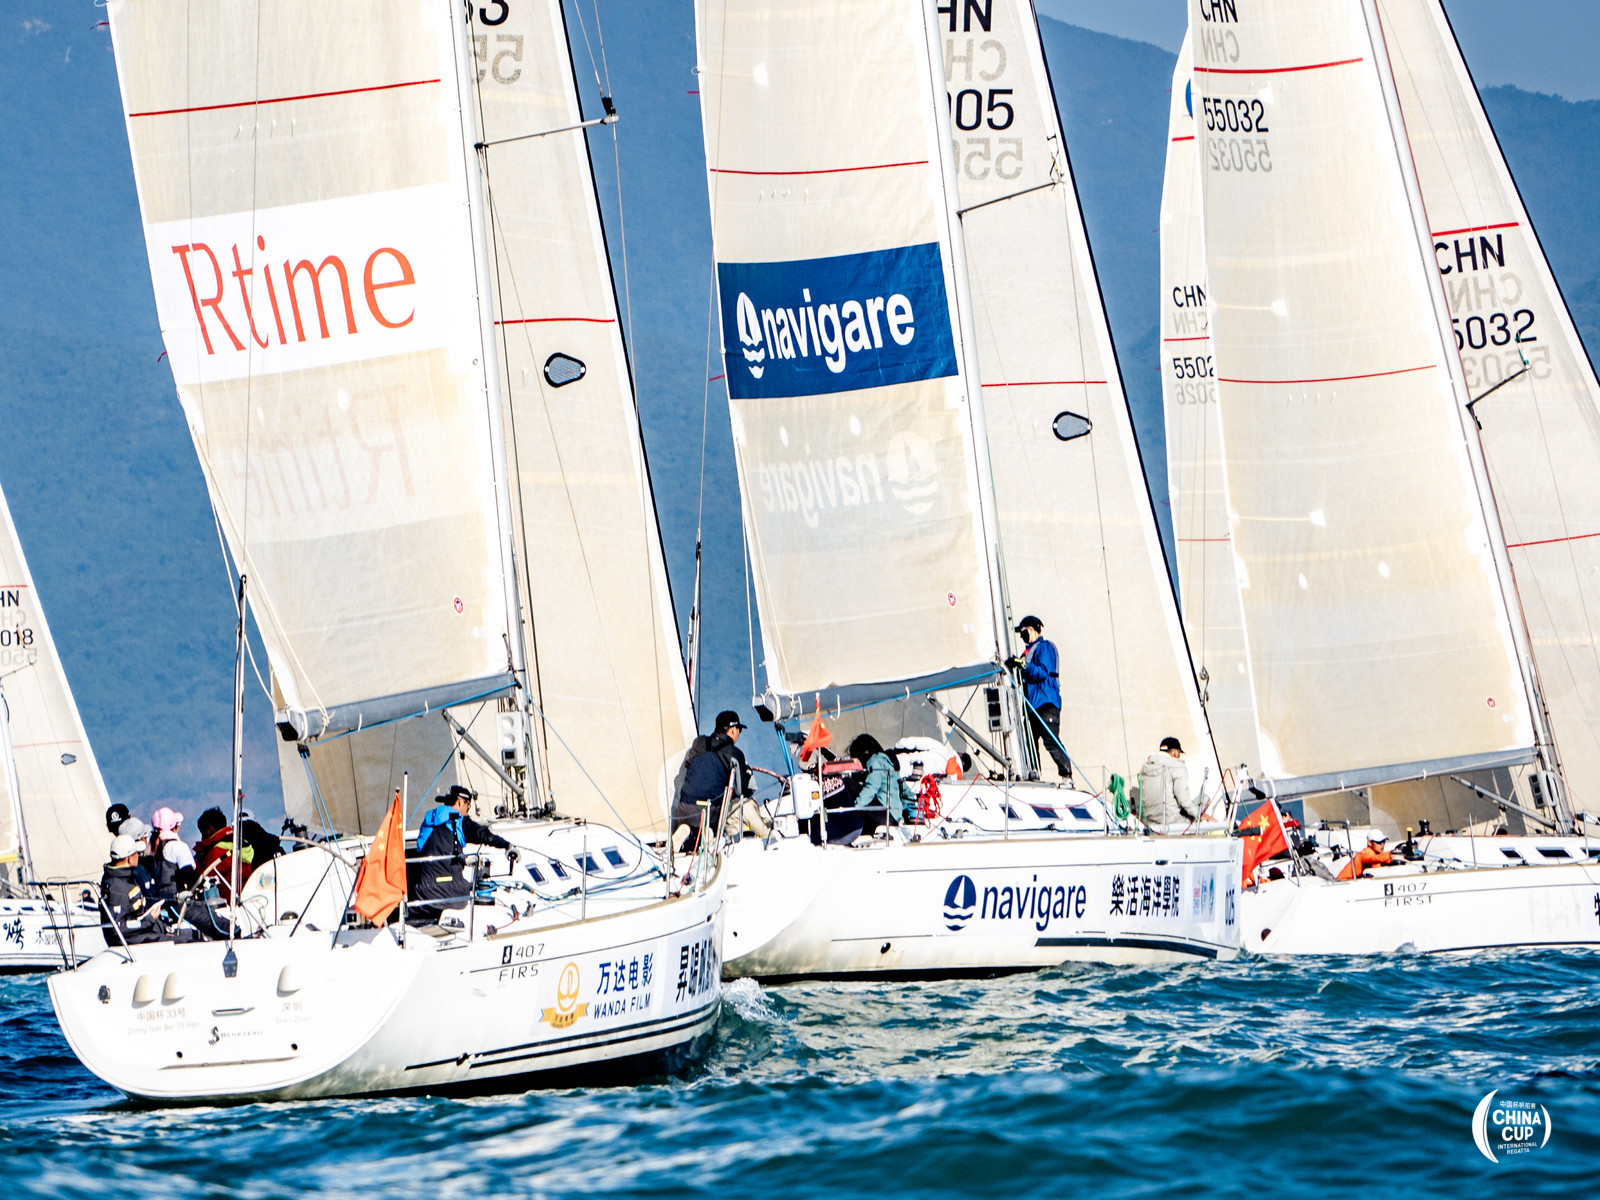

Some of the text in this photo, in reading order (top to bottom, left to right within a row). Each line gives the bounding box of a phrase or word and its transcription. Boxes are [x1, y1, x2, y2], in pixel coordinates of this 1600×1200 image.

[1200, 0, 1239, 23] CHN
[947, 89, 1014, 131] 05
[1203, 97, 1269, 132] 55032
[1434, 233, 1505, 275] CHN
[171, 235, 417, 355] Rtime
[760, 287, 916, 375] navigare
[980, 874, 1087, 932] navigare
[1384, 894, 1432, 908] FIRST
[1397, 882, 1427, 893] 407
[515, 943, 545, 959] 407
[596, 951, 654, 996] 万达电影
[593, 999, 626, 1019] WANDA
[630, 993, 651, 1012] FILM
